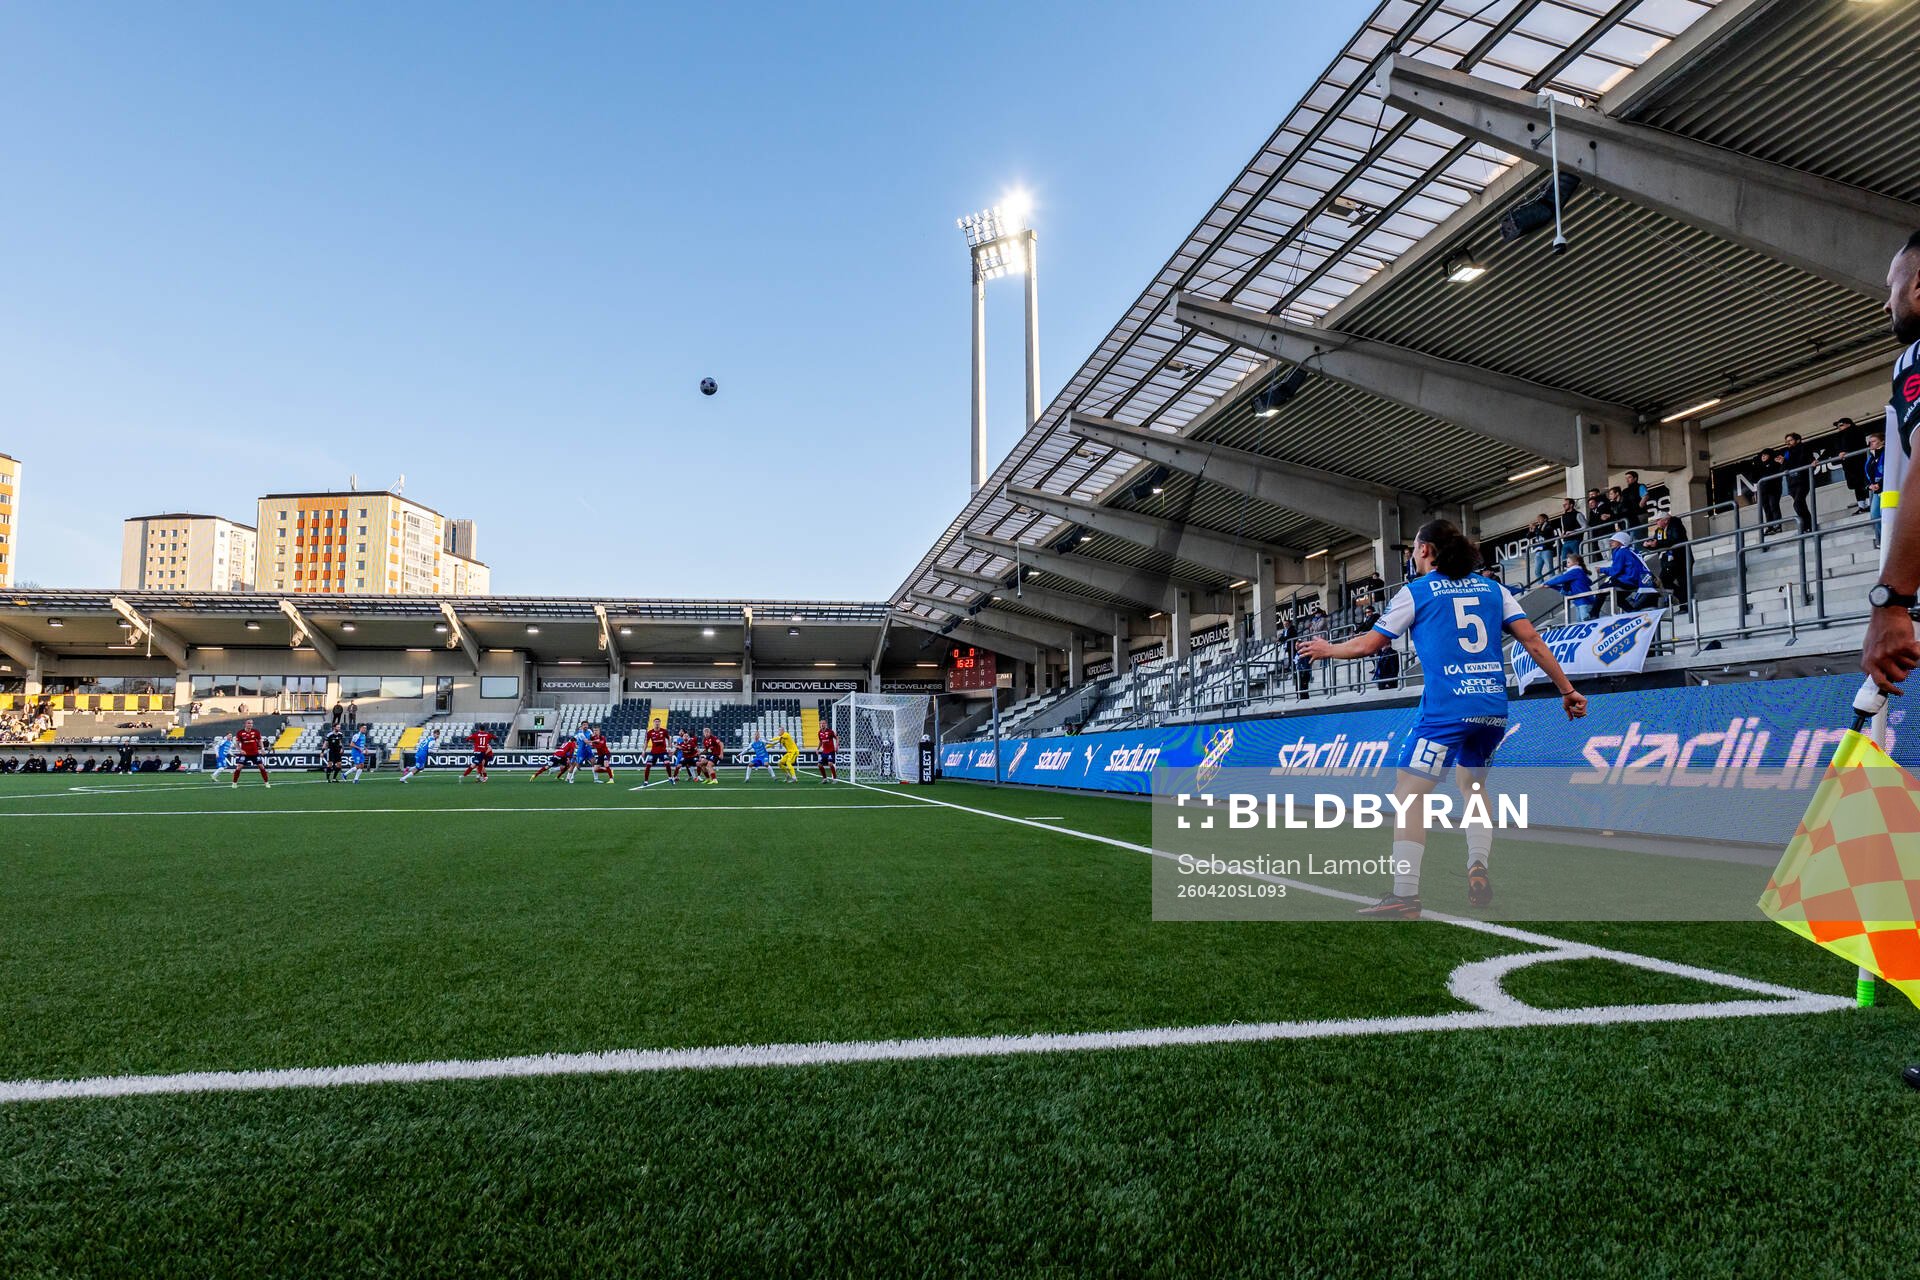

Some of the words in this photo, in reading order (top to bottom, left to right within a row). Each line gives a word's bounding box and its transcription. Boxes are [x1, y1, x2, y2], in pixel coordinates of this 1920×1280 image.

[1453, 597, 1488, 653] 5
[1598, 619, 1642, 651] ODDEVOLD
[1444, 664, 1464, 676] ICA
[1466, 663, 1500, 671] KVANTUM
[634, 680, 733, 690] NORDICWELLNESS
[762, 681, 857, 690] NORDICWELLNESS
[1453, 685, 1504, 696] WELLNESS
[1461, 678, 1497, 687] NORDIC
[1104, 743, 1162, 772] stadium
[1269, 733, 1389, 777] stadium
[922, 750, 932, 782] SELECT
